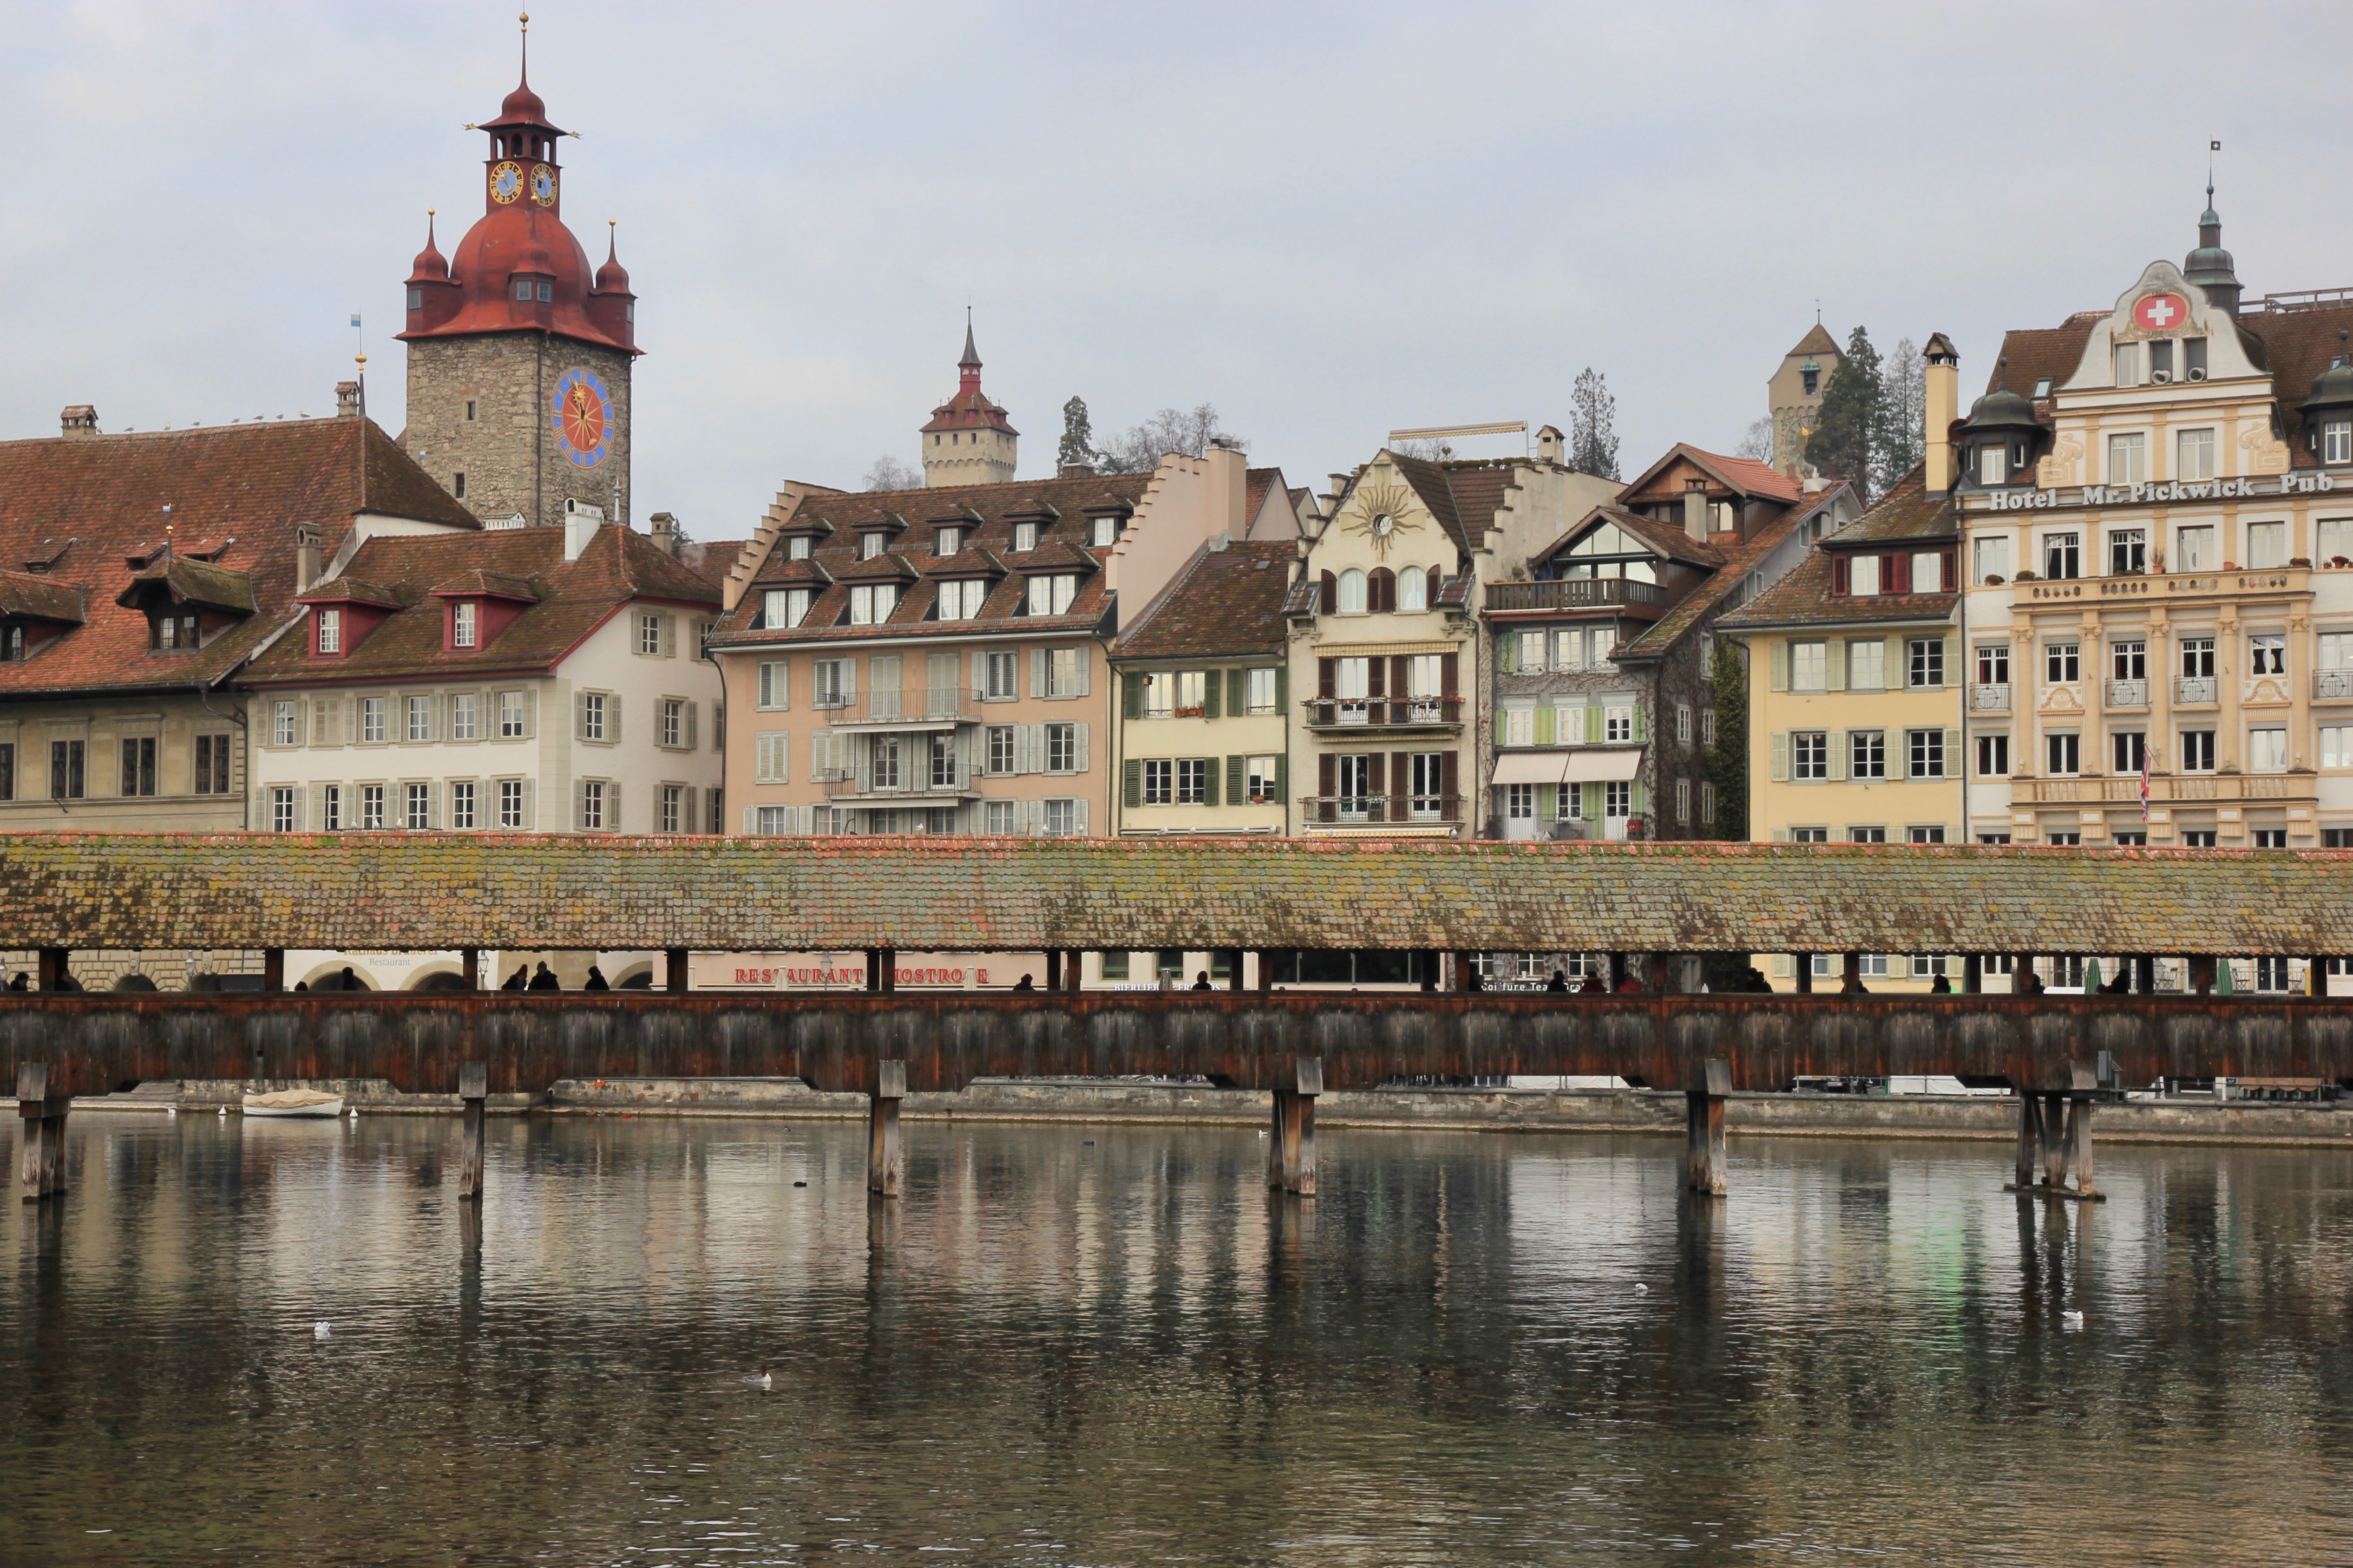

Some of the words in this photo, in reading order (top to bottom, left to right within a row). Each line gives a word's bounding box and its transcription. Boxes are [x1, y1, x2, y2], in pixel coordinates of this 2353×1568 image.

[1989, 488, 2058, 510] Hotel
[2082, 485, 2124, 505] Mr.
[2129, 477, 2255, 502] Pickwick
[2280, 472, 2334, 494] Pub
[894, 968, 989, 983] OSTROE
[1481, 982, 1525, 991] Coifure
